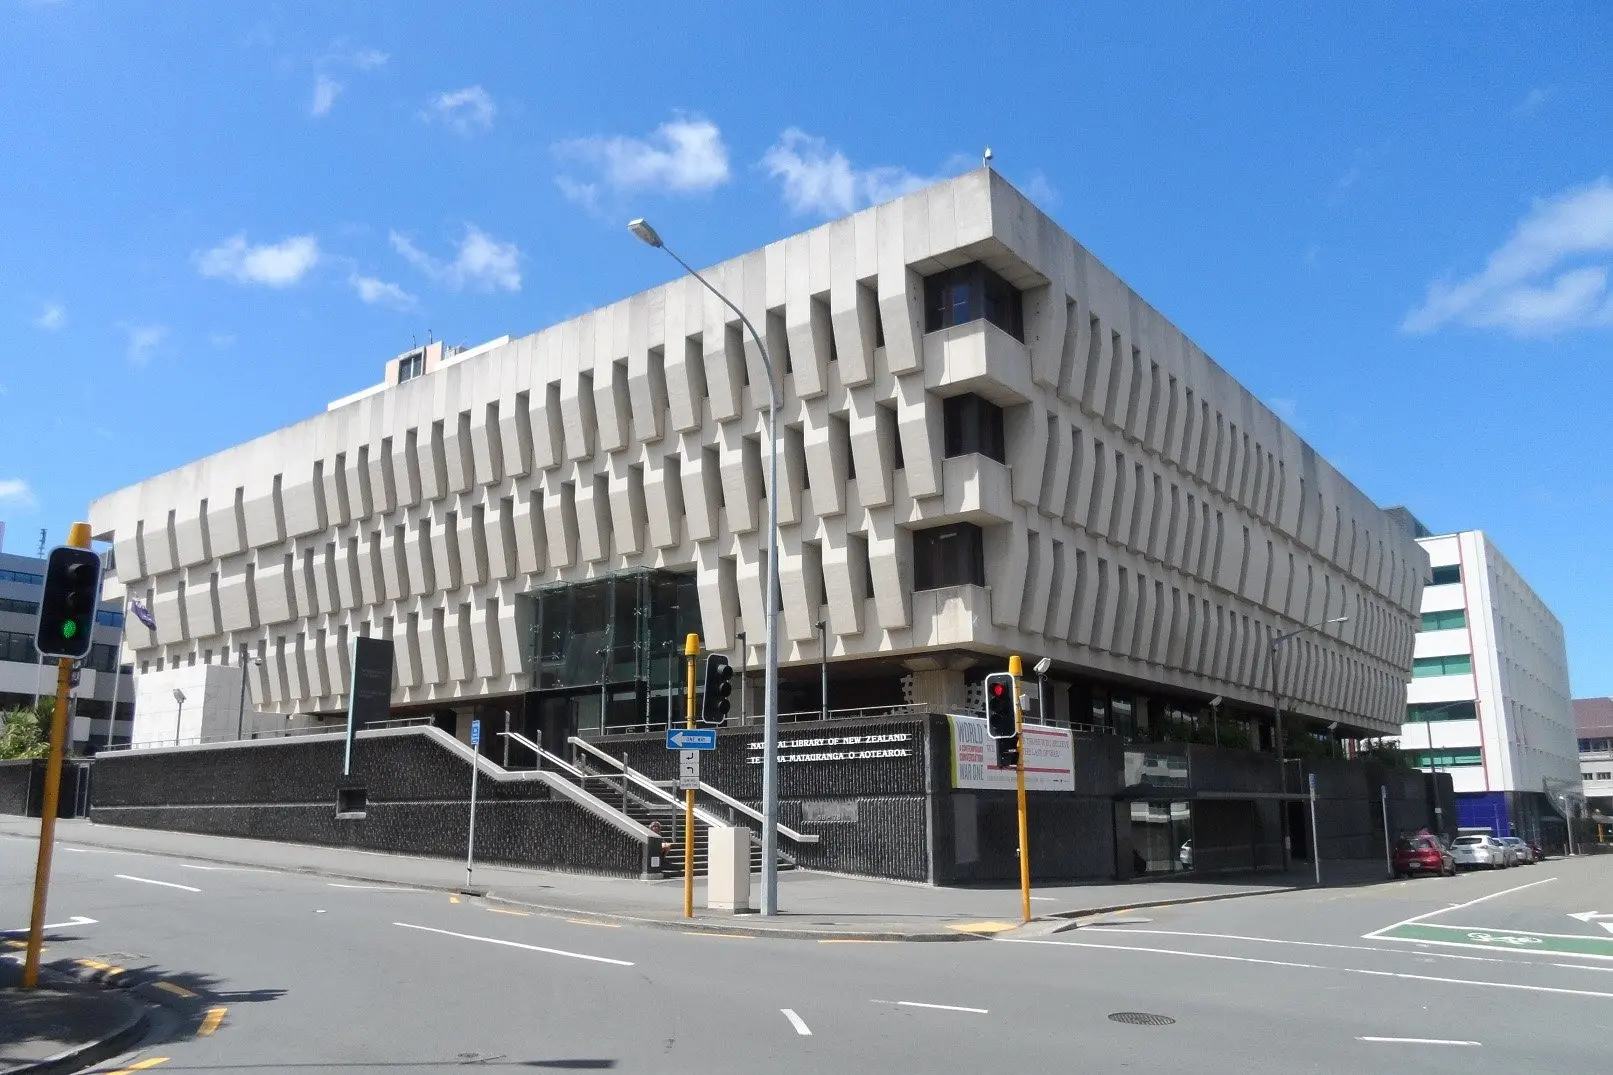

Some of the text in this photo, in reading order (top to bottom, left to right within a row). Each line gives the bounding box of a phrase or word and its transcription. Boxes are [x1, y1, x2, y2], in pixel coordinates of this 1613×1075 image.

[956, 720, 983, 744] WORLD
[750, 740, 786, 749] NATAL
[792, 739, 824, 747] LIBRARY
[843, 736, 861, 744] NEW
[865, 734, 906, 743] ZEALAND
[789, 753, 844, 762] MATAURANGA
[848, 751, 855, 759] O
[860, 749, 907, 759] AOTEAROA
[959, 764, 984, 780] WAR ONE
